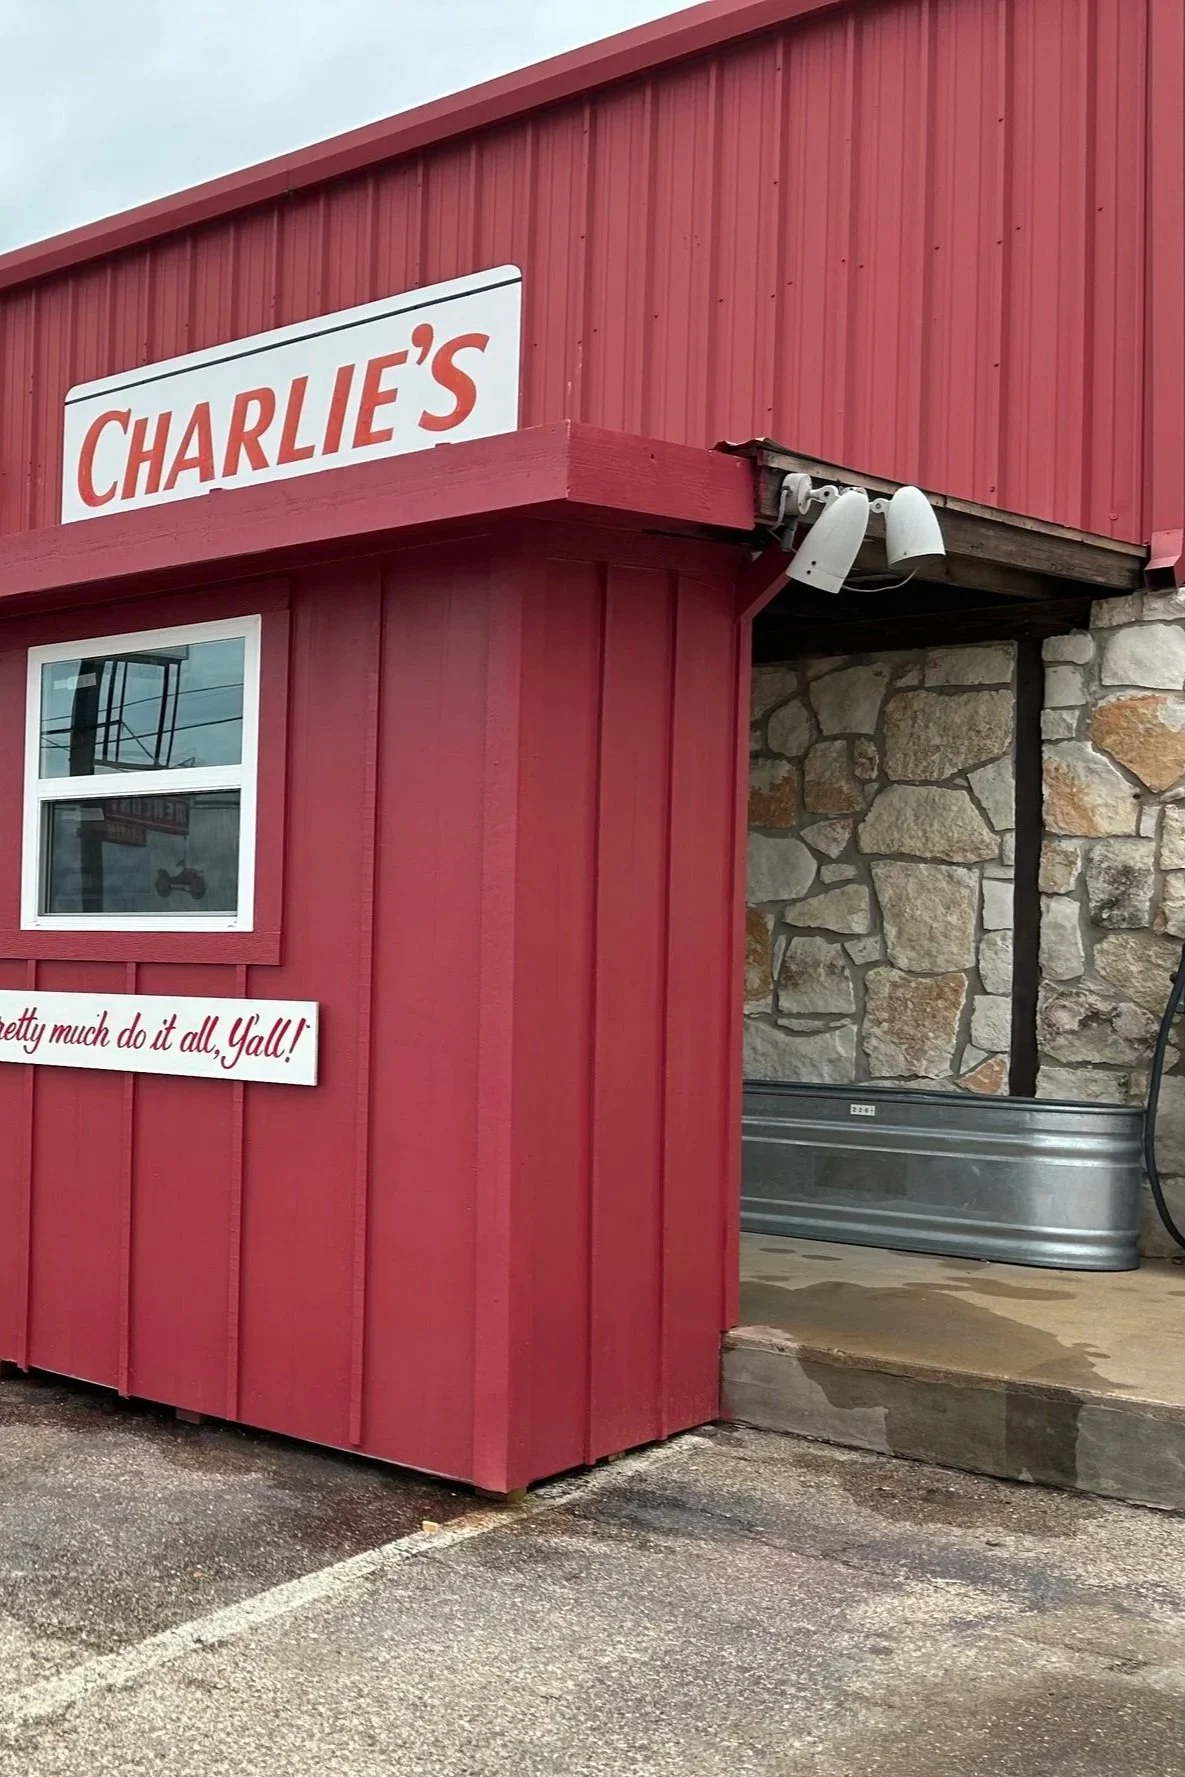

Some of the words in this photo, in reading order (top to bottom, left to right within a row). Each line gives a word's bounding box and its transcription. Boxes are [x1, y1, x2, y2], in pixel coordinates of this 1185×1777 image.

[77, 323, 490, 508] CHARLIE'S
[48, 1010, 111, 1047] much
[116, 1012, 146, 1049] do
[149, 1013, 175, 1051] it
[179, 1015, 221, 1059] all,
